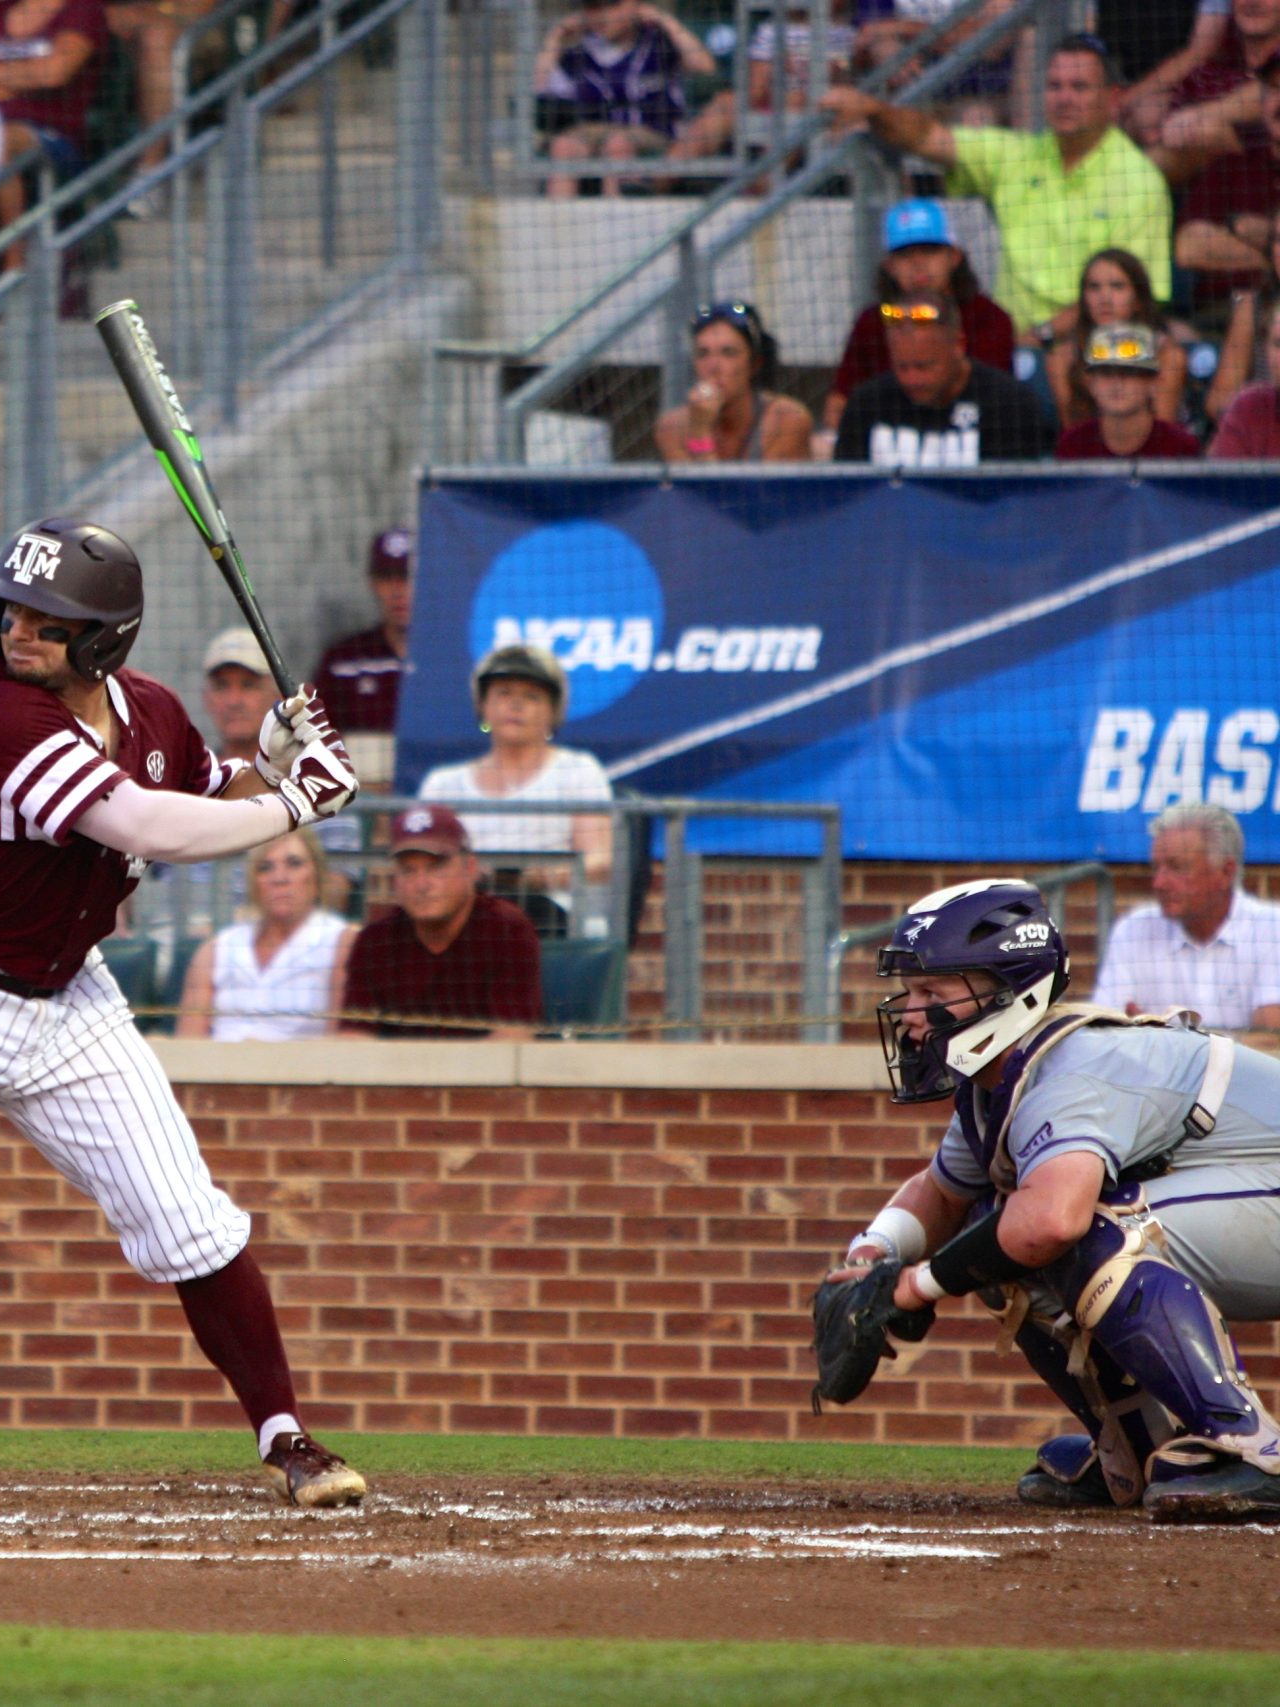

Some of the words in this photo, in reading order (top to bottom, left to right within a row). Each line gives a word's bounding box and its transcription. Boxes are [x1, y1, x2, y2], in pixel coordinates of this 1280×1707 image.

[493, 617, 822, 672] NCAA.com
[1078, 709, 1280, 814] BAS
[1009, 940, 1047, 950] EASTON
[1015, 923, 1049, 942] TCU
